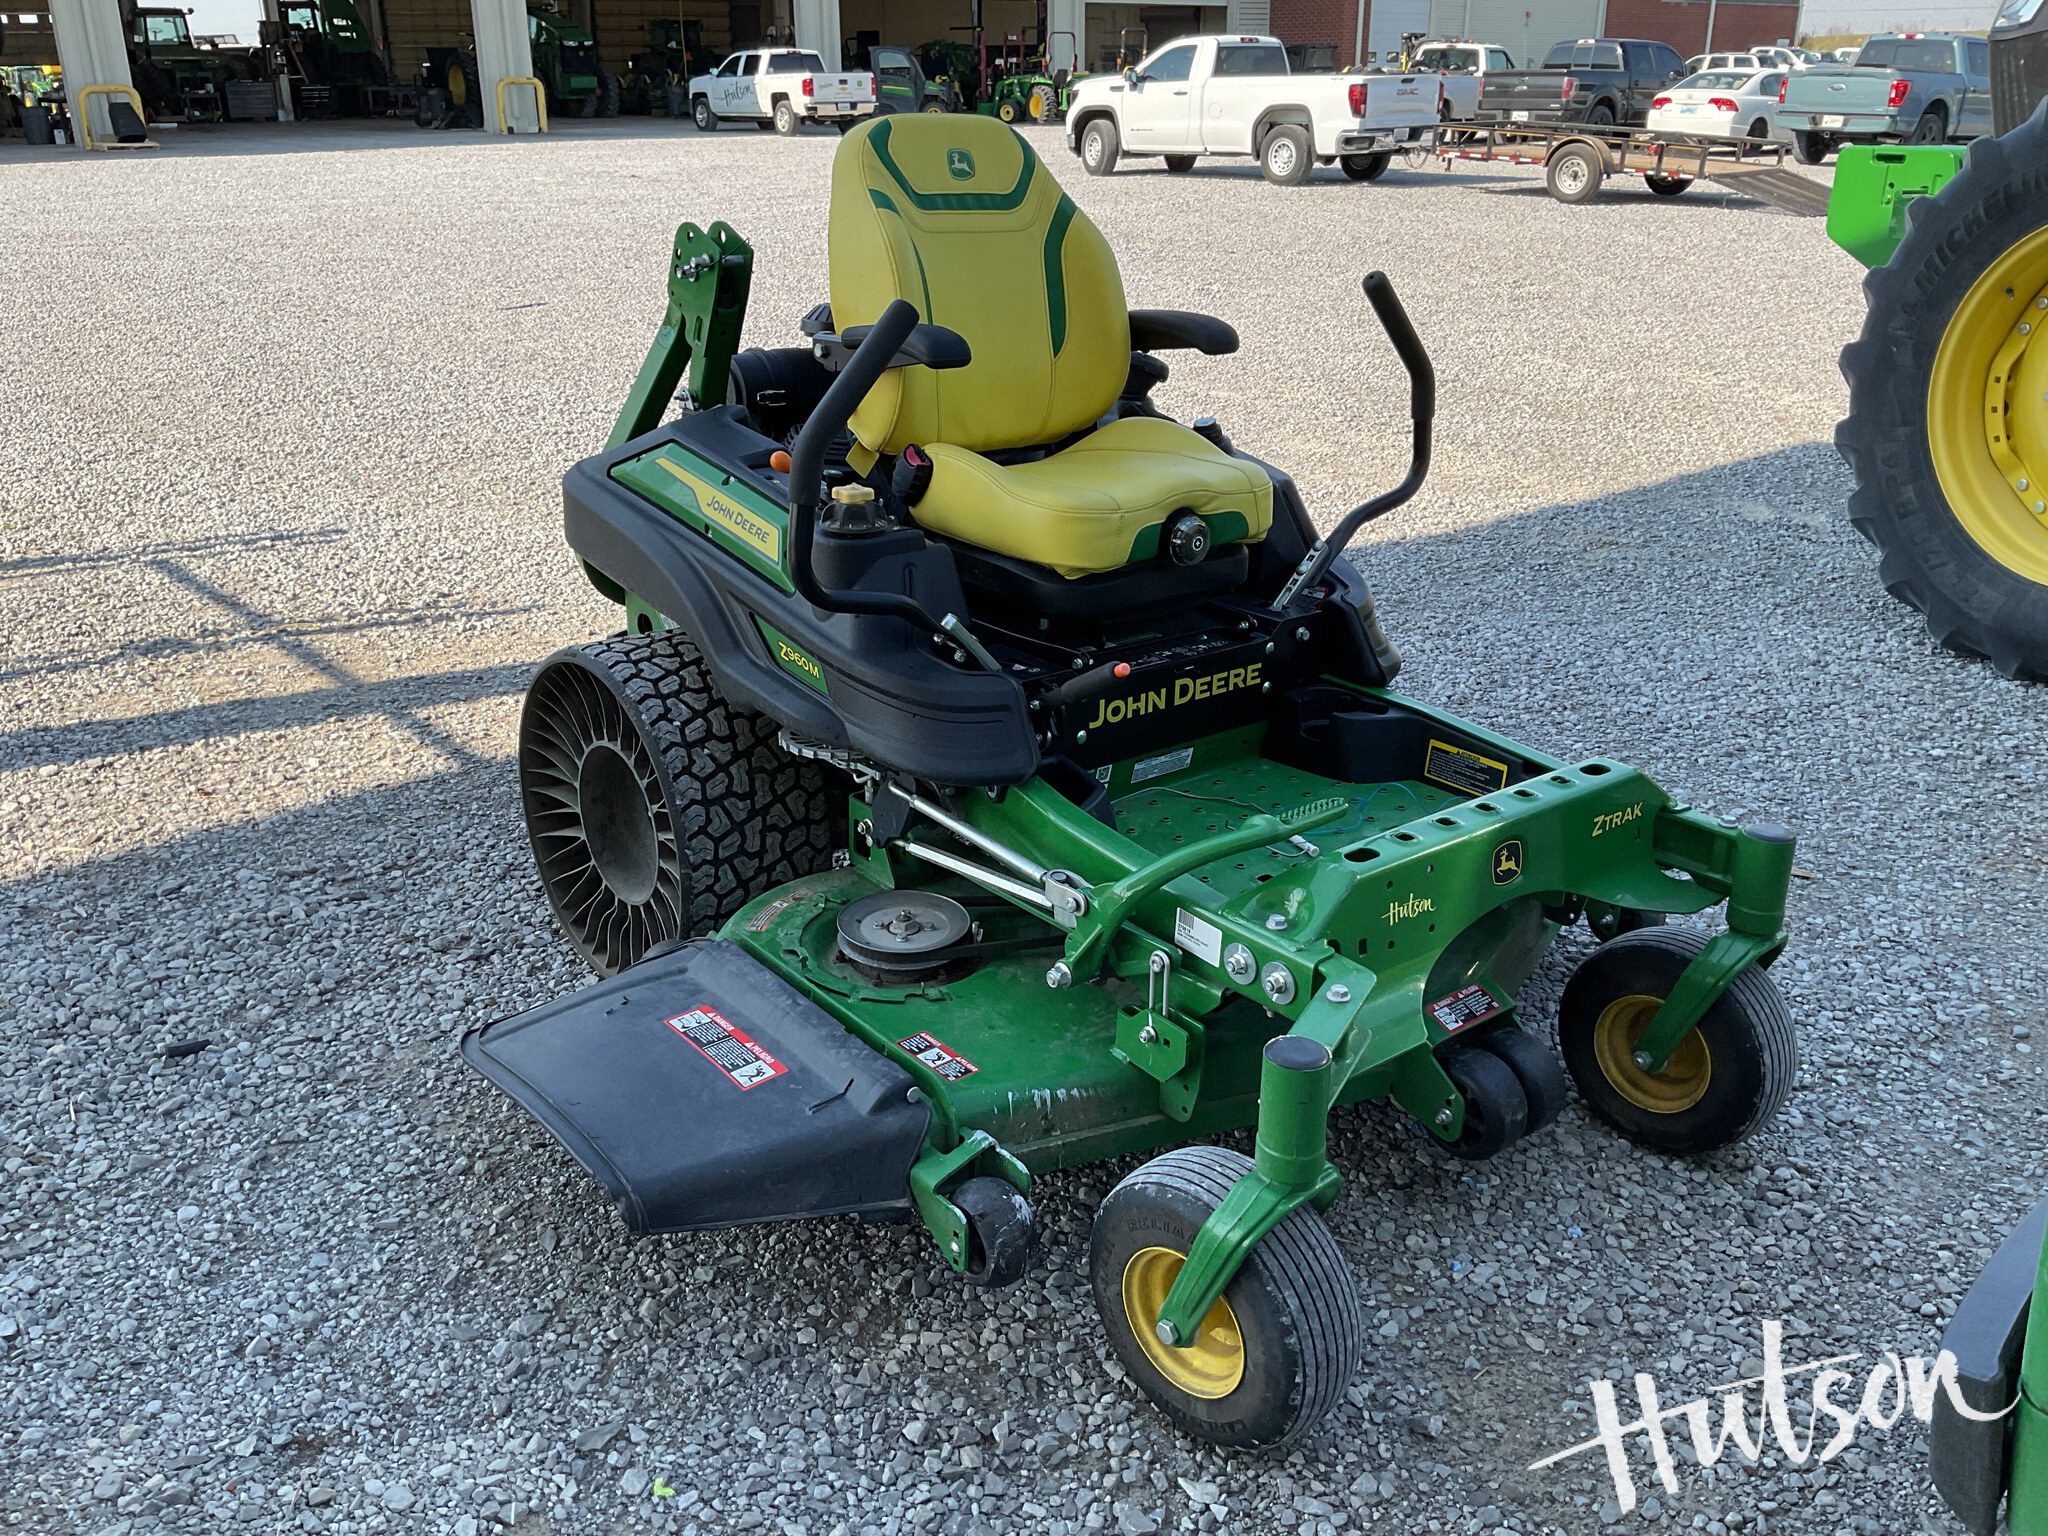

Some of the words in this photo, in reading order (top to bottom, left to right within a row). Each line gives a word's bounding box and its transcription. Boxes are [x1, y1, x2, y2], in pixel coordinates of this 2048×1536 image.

[713, 80, 754, 107] Hutson
[1397, 88, 1419, 96] GMC
[706, 495, 734, 522] JOHN
[733, 510, 770, 544] DEERE
[778, 641, 819, 679] Z960M
[1089, 688, 1167, 729] JOHN
[1174, 662, 1262, 706] DEERE
[1592, 801, 1643, 837] ZTRAK
[1381, 892, 1437, 926] Hutson
[712, 1015, 735, 1032] DANGER
[750, 1045, 775, 1064] PELIGRO
[958, 1058, 979, 1072] PELIGRO
